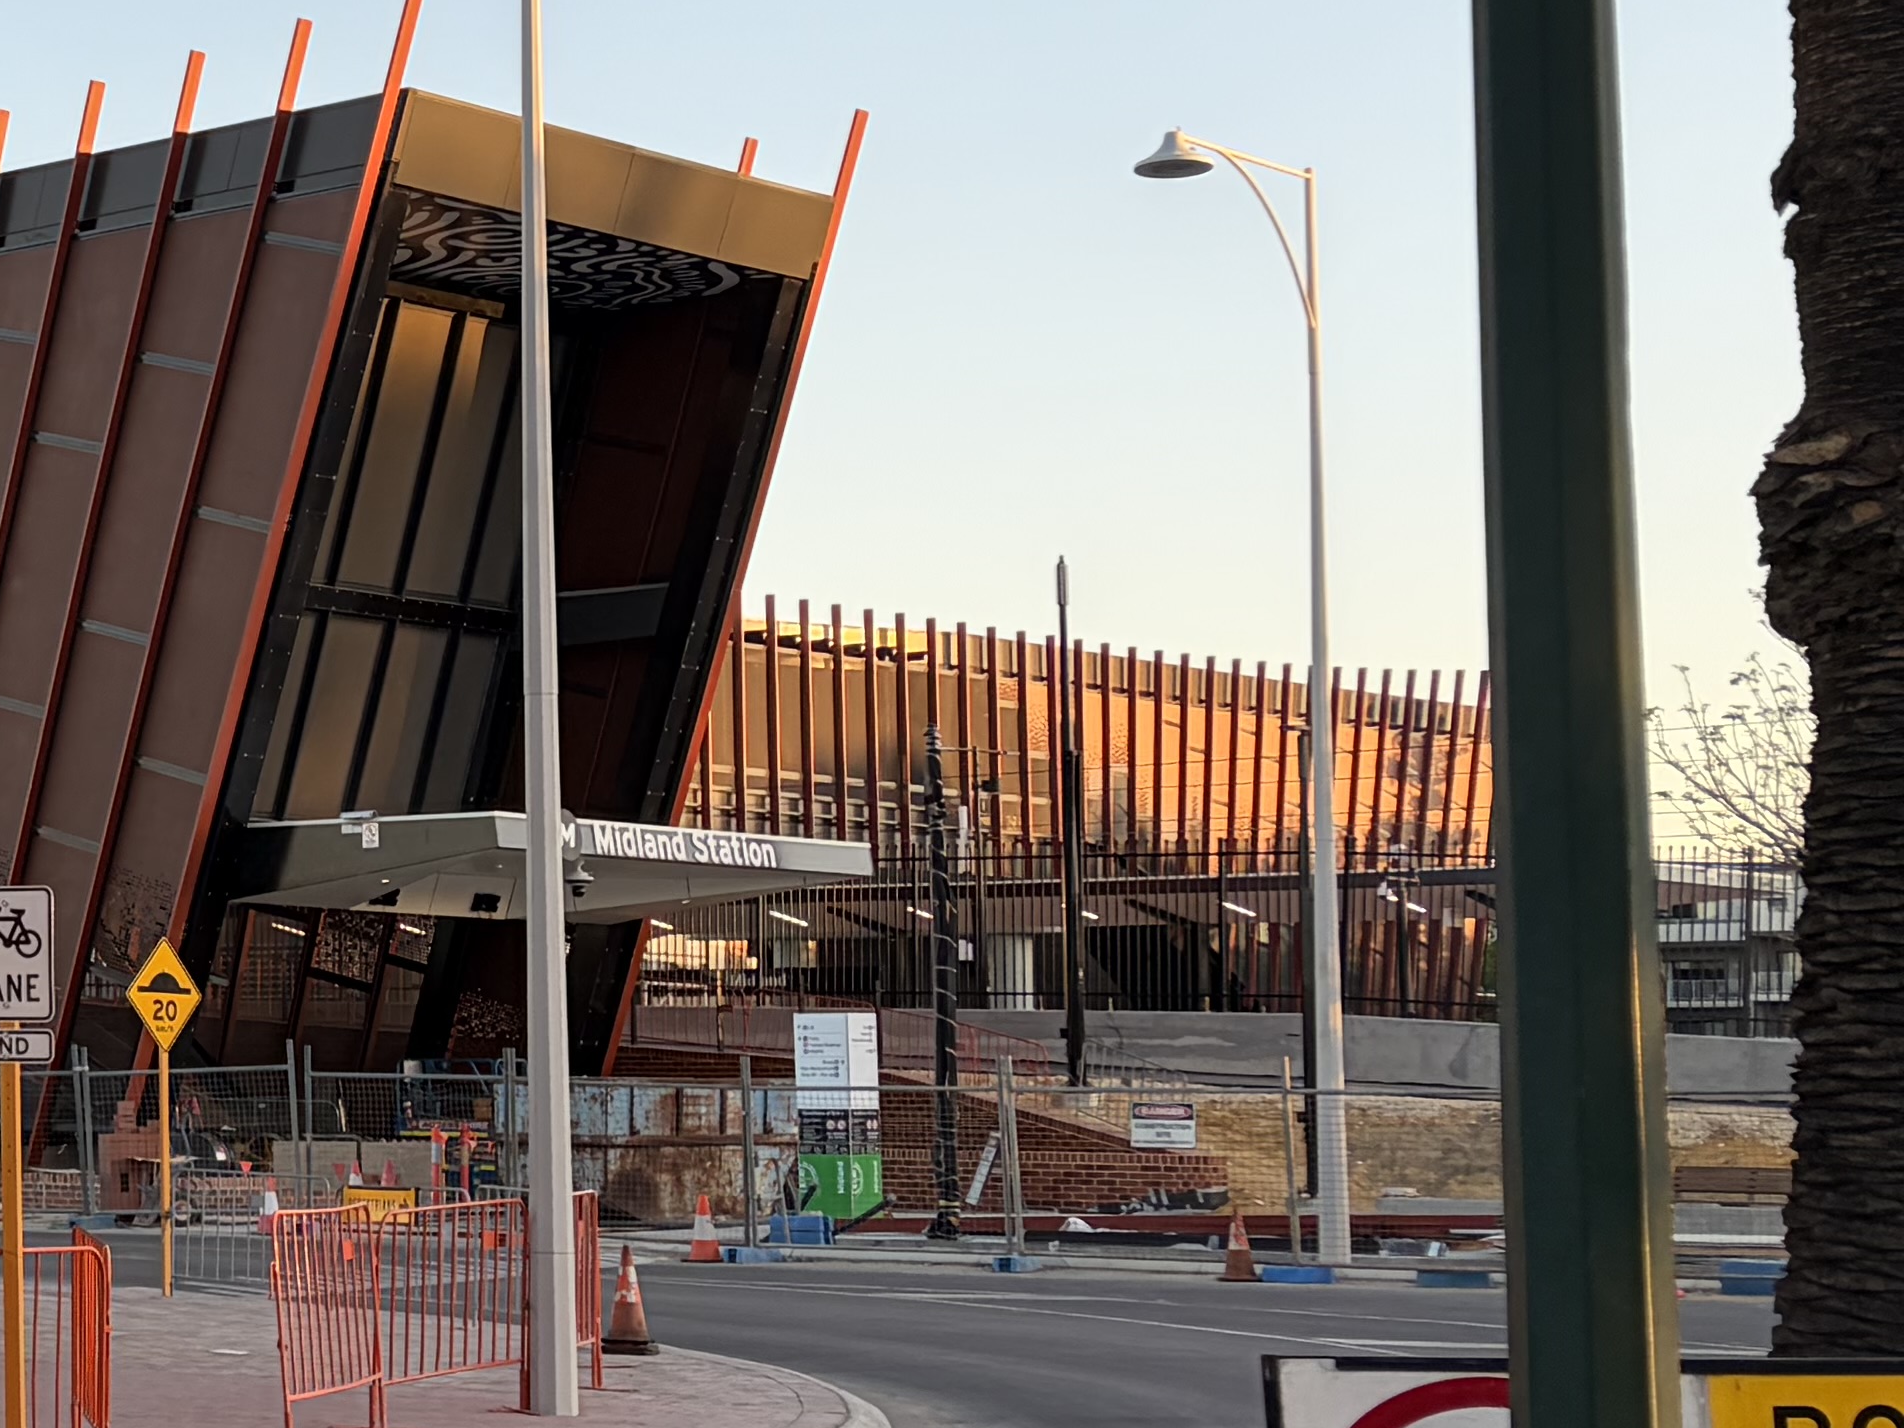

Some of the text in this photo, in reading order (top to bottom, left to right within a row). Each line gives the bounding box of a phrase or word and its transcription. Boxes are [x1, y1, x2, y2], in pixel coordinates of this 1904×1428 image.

[593, 823, 686, 861] Midland
[692, 832, 777, 869] Station
[153, 999, 177, 1022] 20
